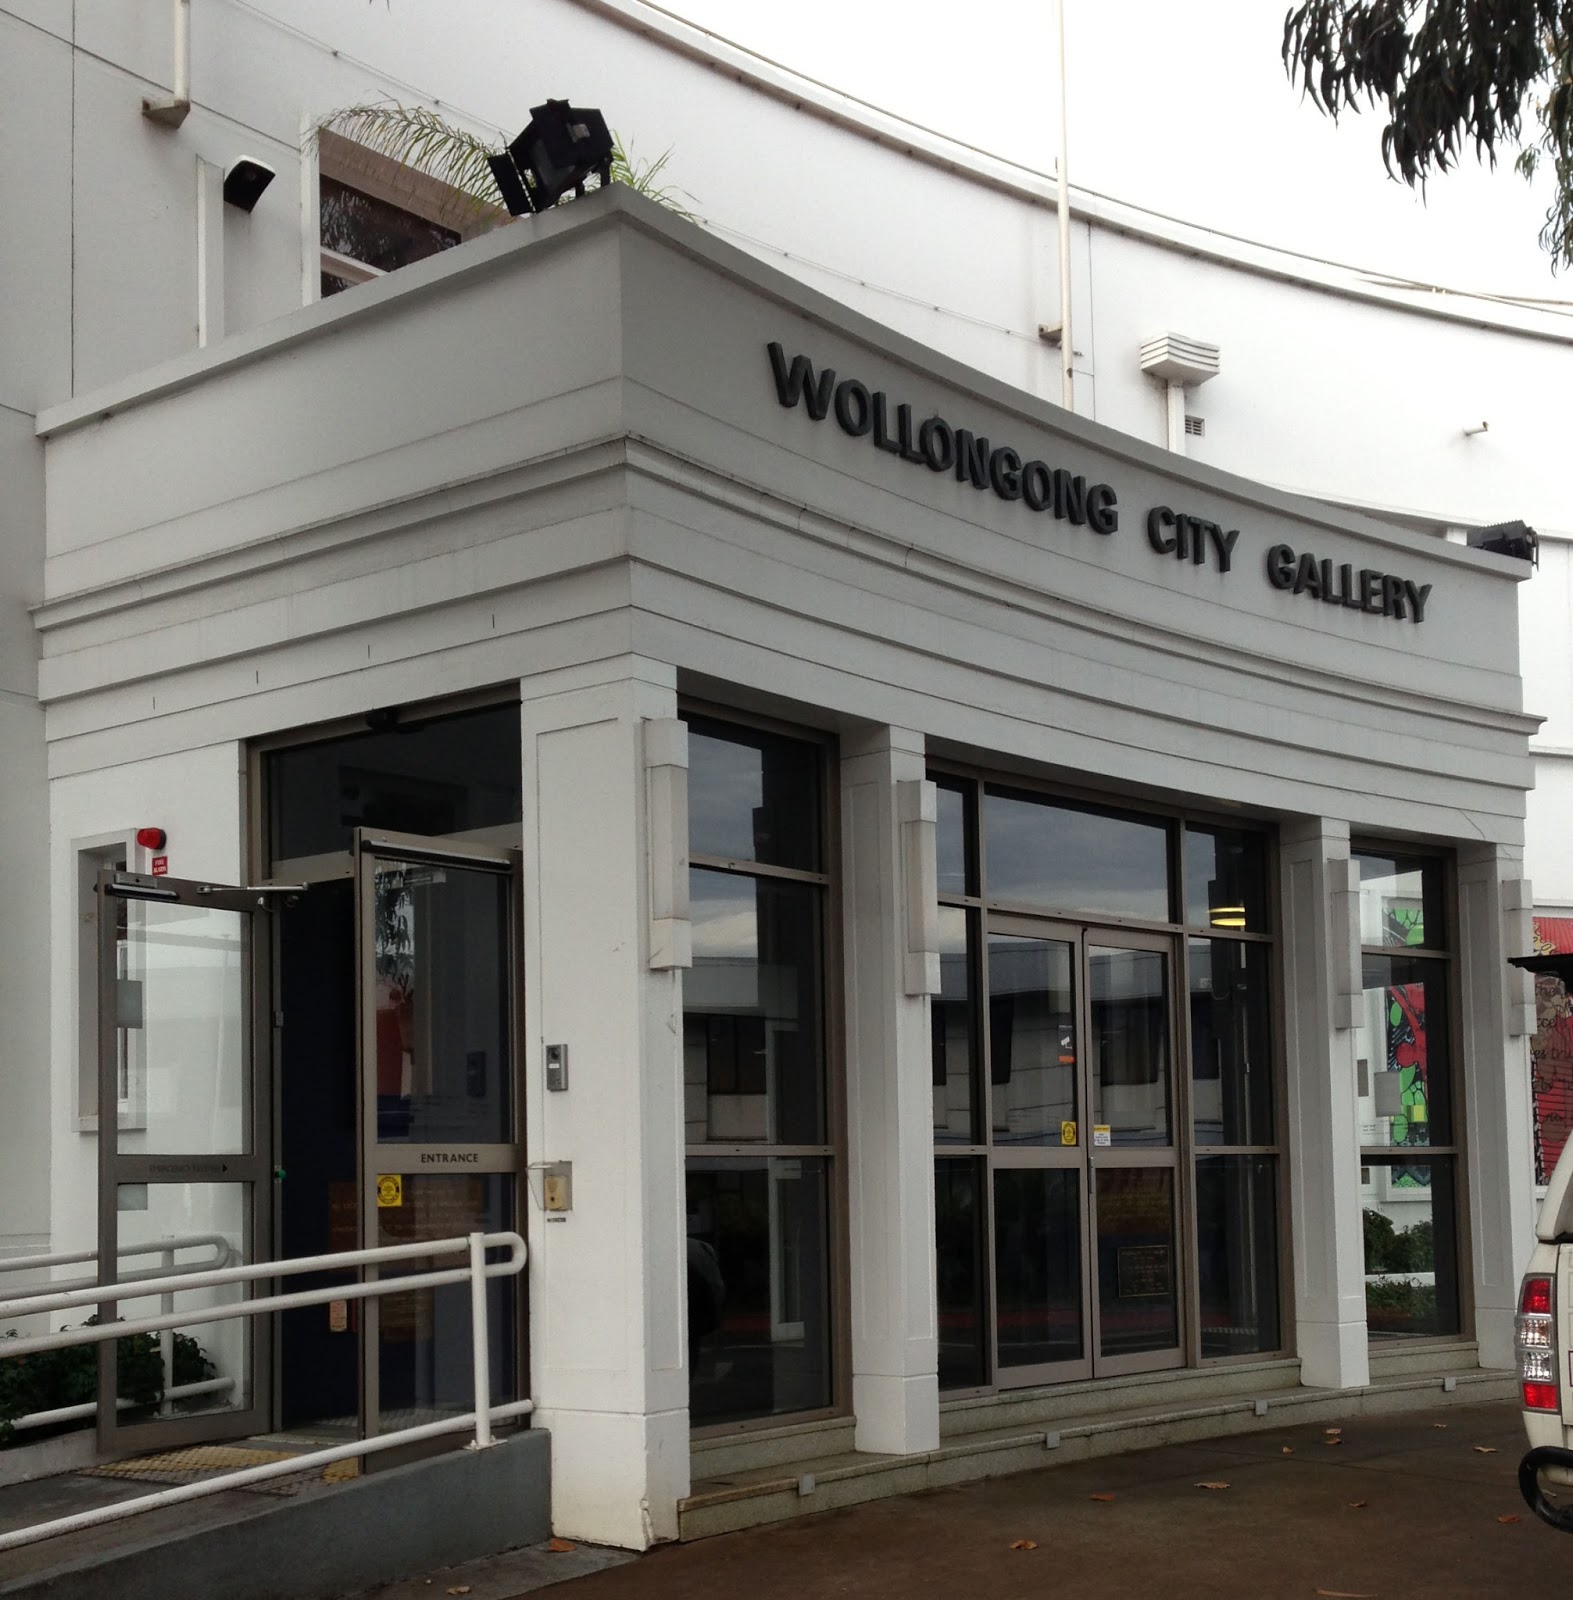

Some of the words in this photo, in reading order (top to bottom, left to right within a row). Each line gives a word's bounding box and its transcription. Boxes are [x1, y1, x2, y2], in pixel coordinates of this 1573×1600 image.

[766, 342, 1118, 534] WOLLONGONG
[1147, 506, 1239, 573] CITY
[1267, 544, 1432, 623] GALLERY
[420, 1153, 479, 1163] ENTRANCE
